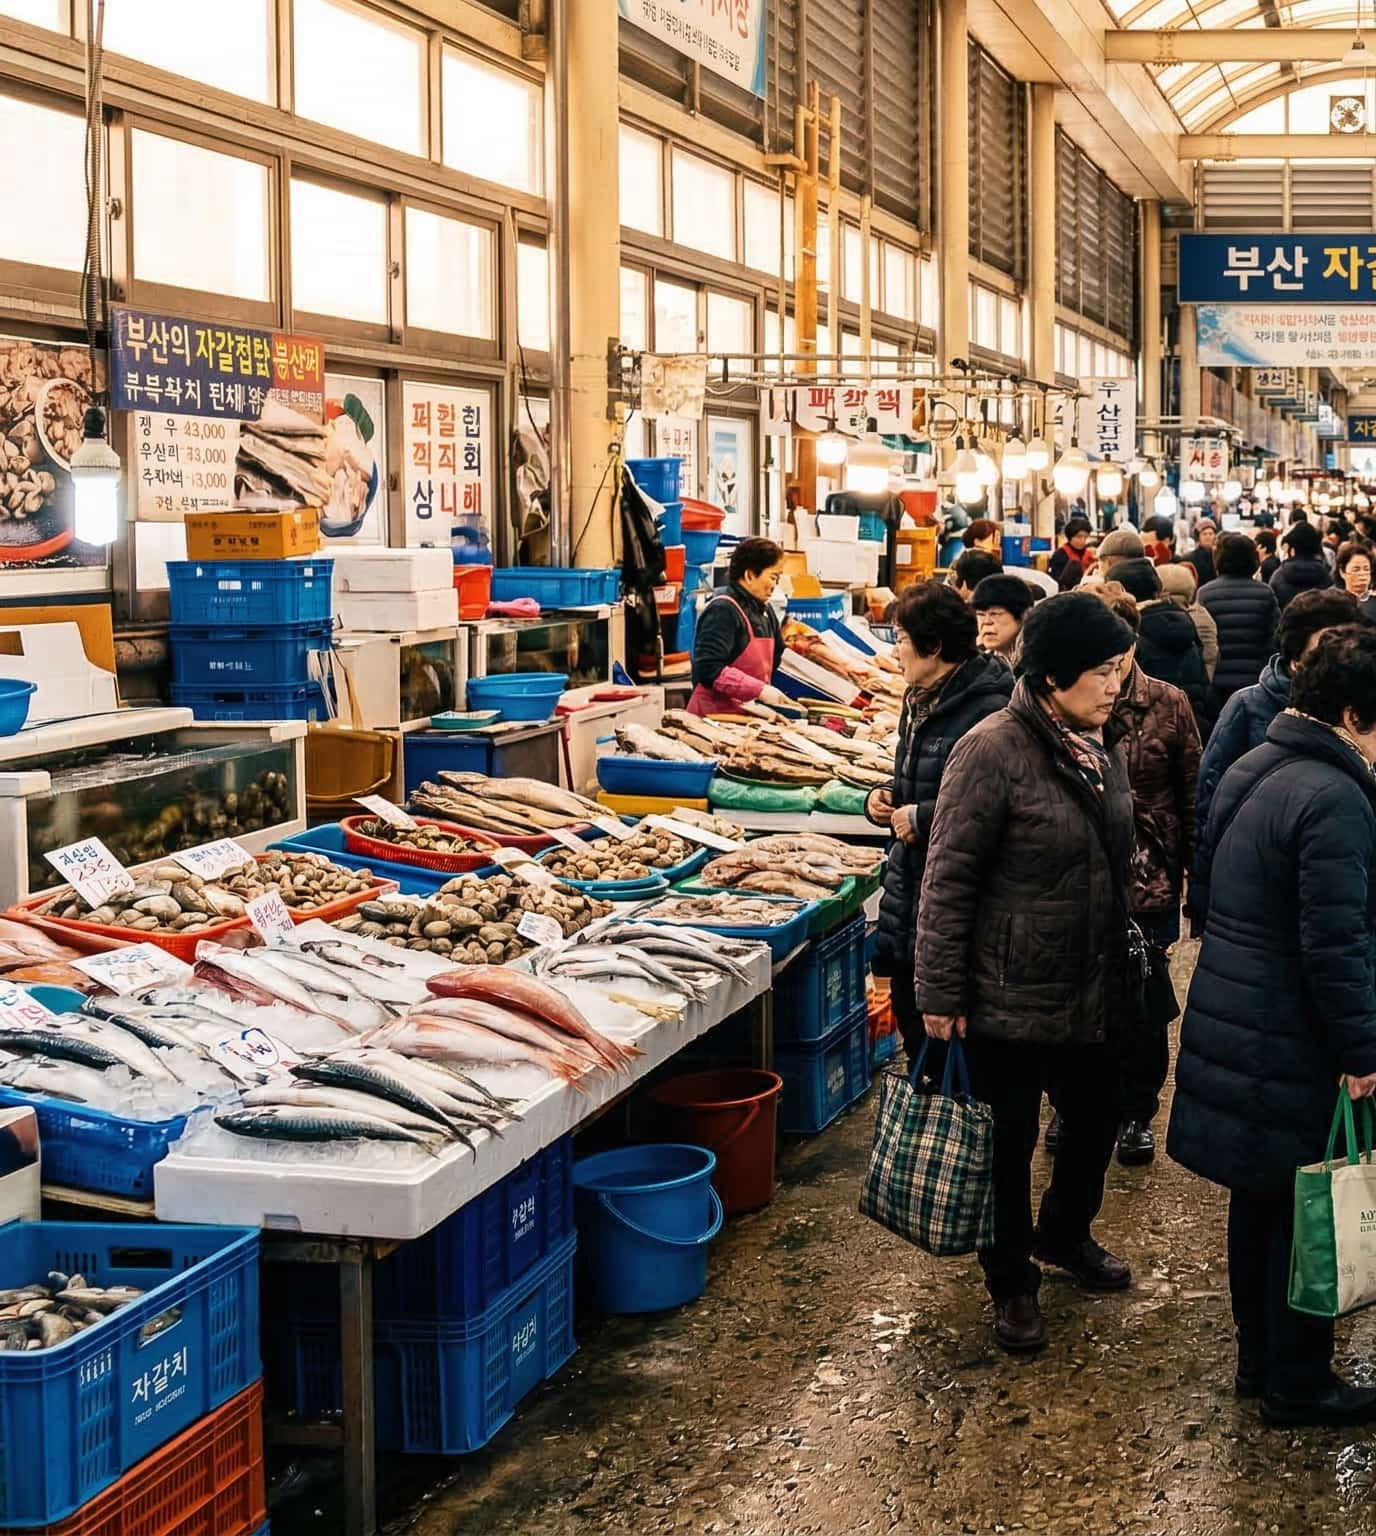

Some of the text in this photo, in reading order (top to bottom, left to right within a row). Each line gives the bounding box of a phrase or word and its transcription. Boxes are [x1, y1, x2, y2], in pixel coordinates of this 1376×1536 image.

[1223, 245, 1309, 292] 부산
[126, 313, 191, 367] 부산의
[131, 1345, 188, 1403] 자갈치
